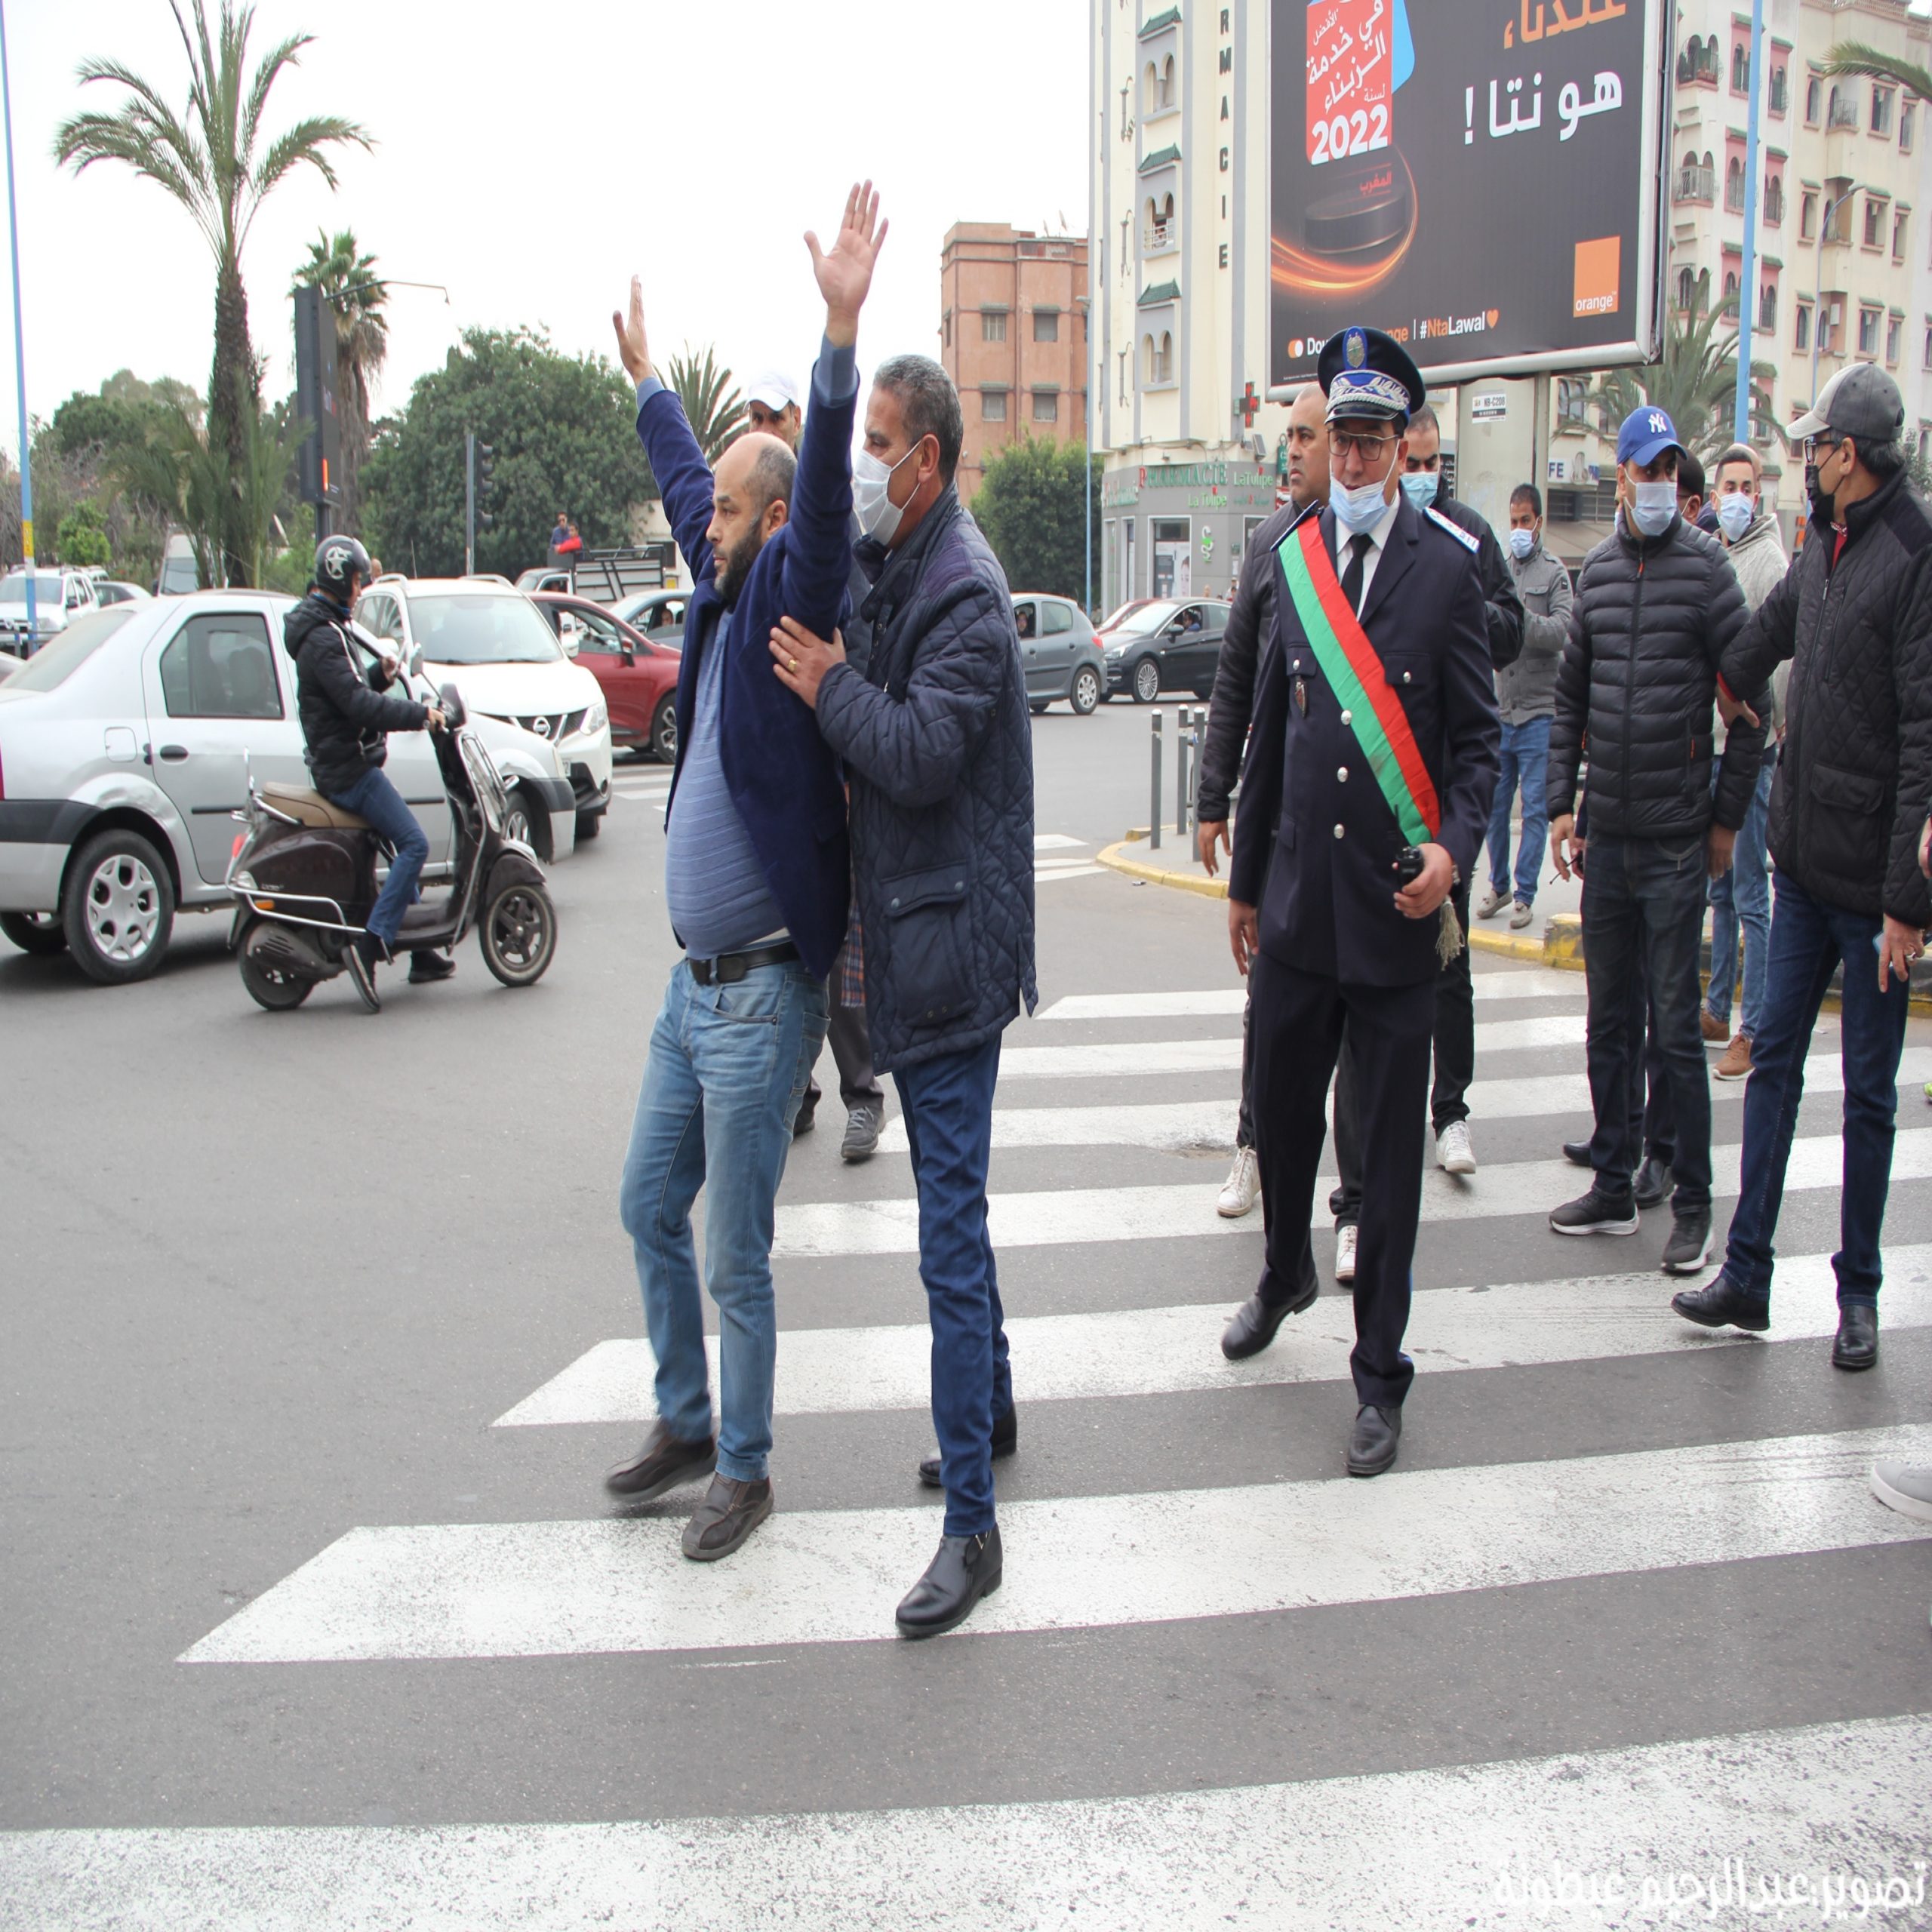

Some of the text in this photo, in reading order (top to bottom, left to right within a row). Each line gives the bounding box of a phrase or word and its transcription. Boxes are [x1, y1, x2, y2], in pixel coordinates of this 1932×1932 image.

[1306, 26, 1353, 85] خدمة
[1324, 30, 1387, 115] الزبناء
[1364, 83, 1386, 103] لسنة
[1558, 72, 1623, 142] هو
[1311, 103, 1389, 165] 2022
[1359, 171, 1392, 195] المغرب
[1575, 295, 1613, 312] orange
[1420, 311, 1485, 337] #NtaLawal
[1139, 462, 1228, 489] PHARMACIE
